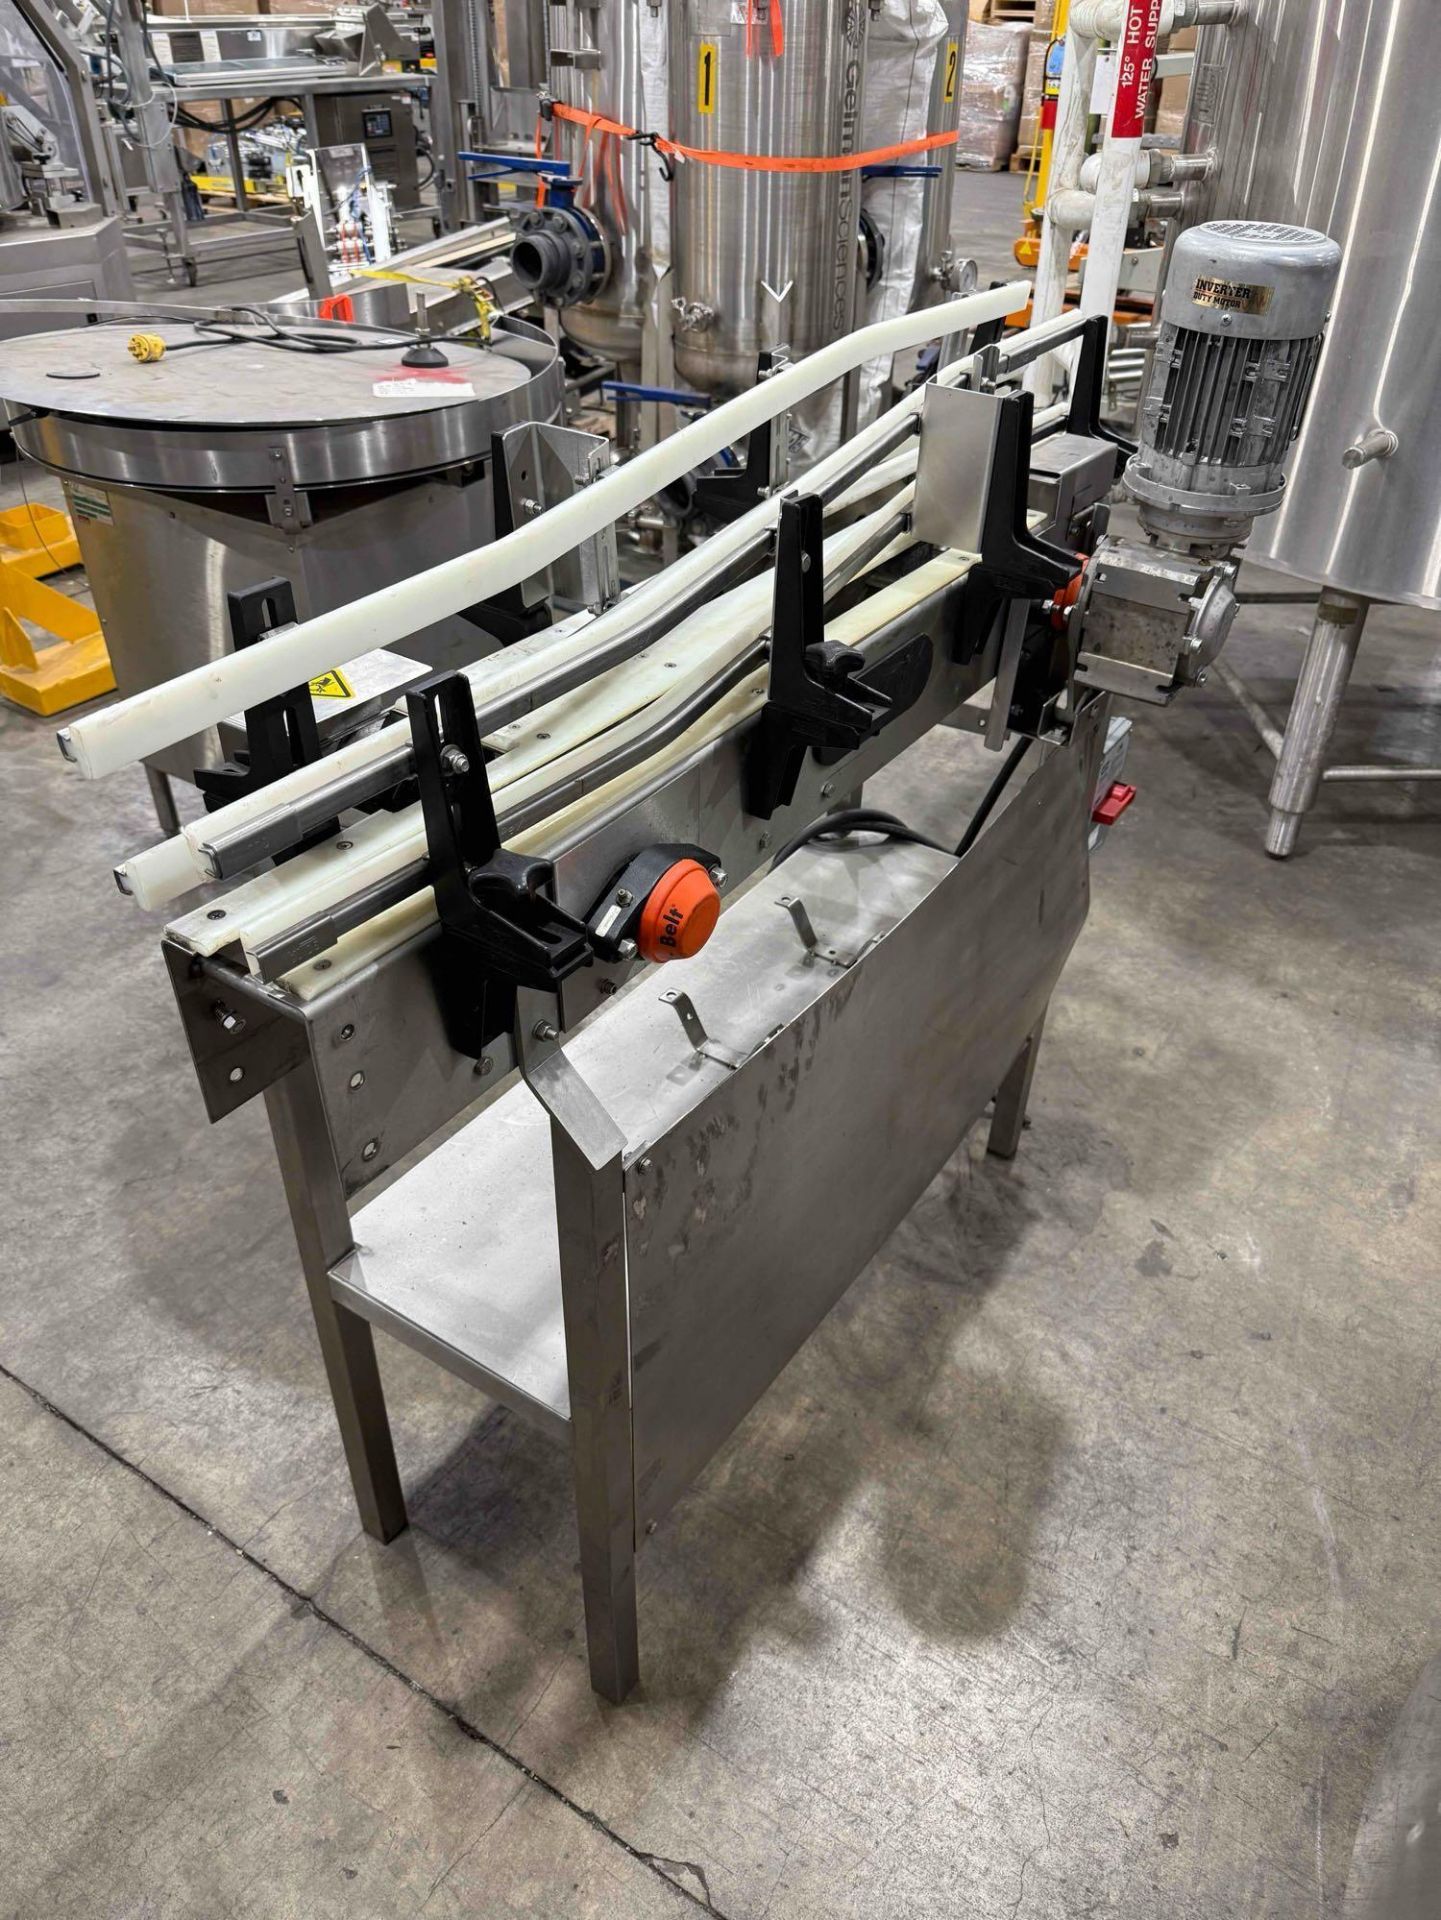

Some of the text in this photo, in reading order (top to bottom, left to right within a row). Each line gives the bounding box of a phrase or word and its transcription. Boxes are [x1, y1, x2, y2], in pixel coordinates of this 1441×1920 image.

[1122, 6, 1143, 88] 125° HOT
[704, 51, 711, 106] 1
[946, 51, 956, 97] 2
[1135, 58, 1152, 119] WATER
[1193, 291, 1241, 309] DUTY MOTOR
[1195, 279, 1251, 299] INVERTER
[659, 908, 684, 947] Belt
